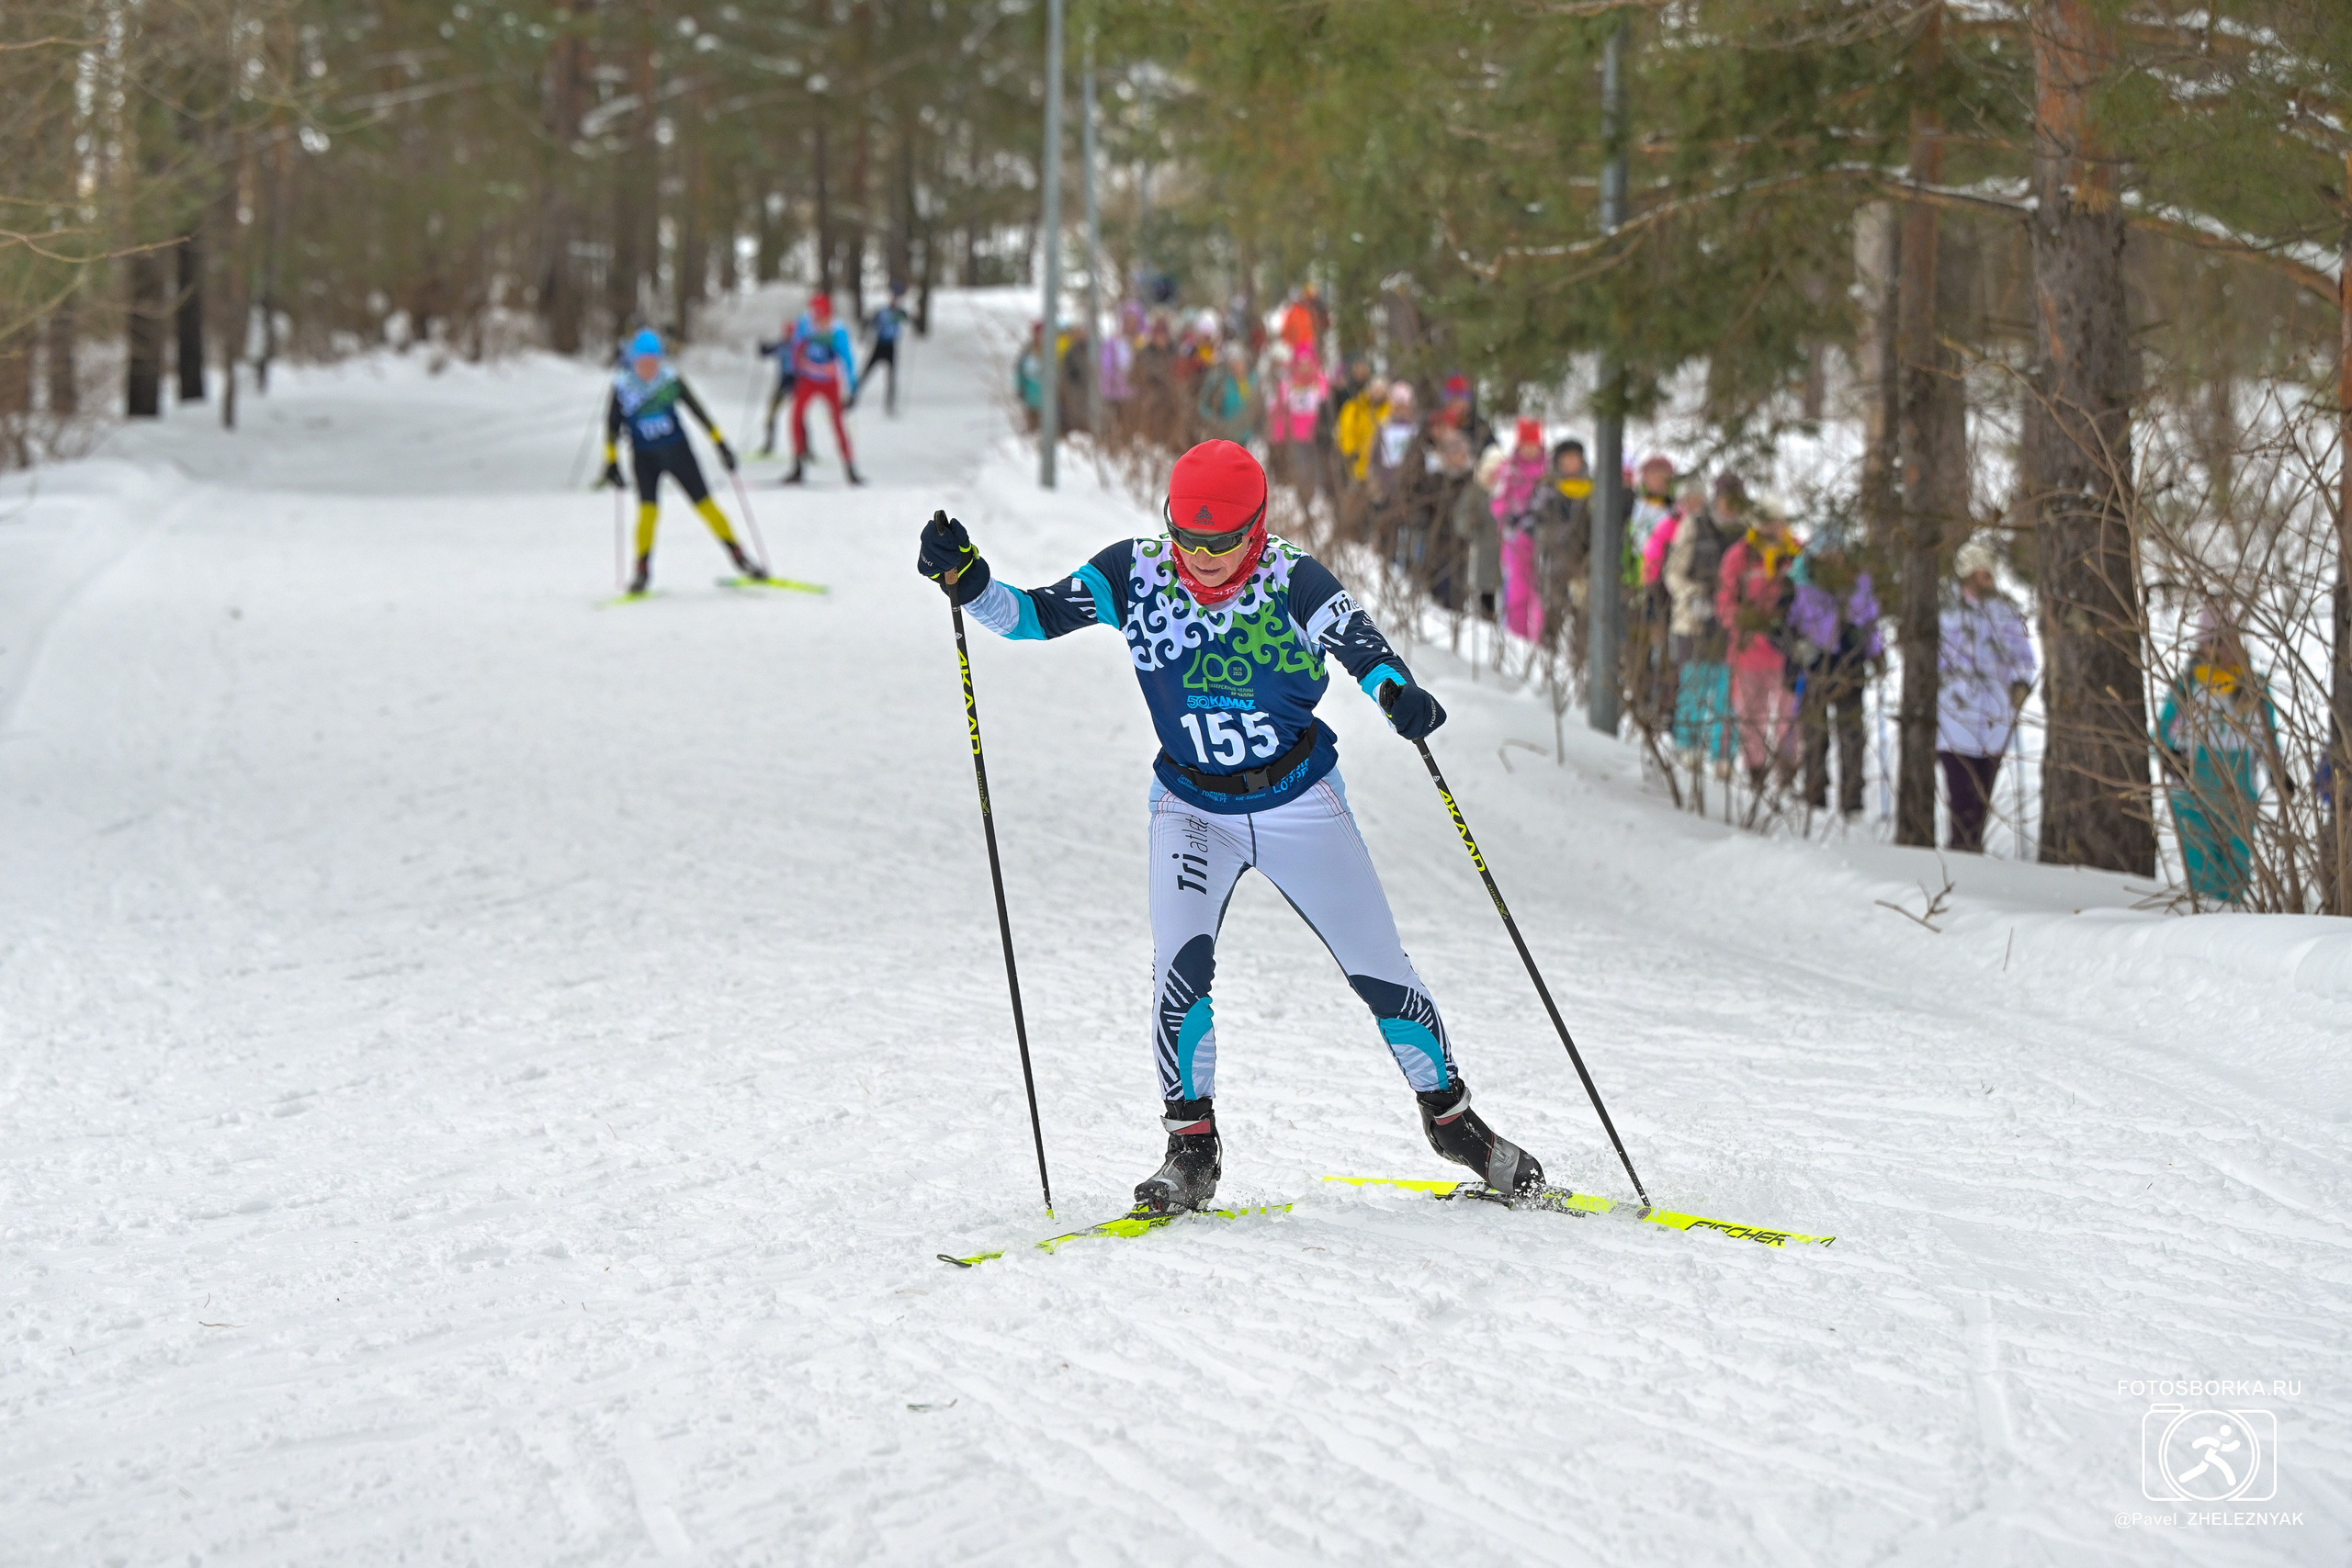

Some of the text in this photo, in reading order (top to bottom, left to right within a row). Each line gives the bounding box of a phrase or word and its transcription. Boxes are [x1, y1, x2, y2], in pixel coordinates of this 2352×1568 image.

[1182, 649, 1252, 692] 400
[1209, 695, 1256, 711] KAMAZ
[1180, 711, 1280, 766] 155
